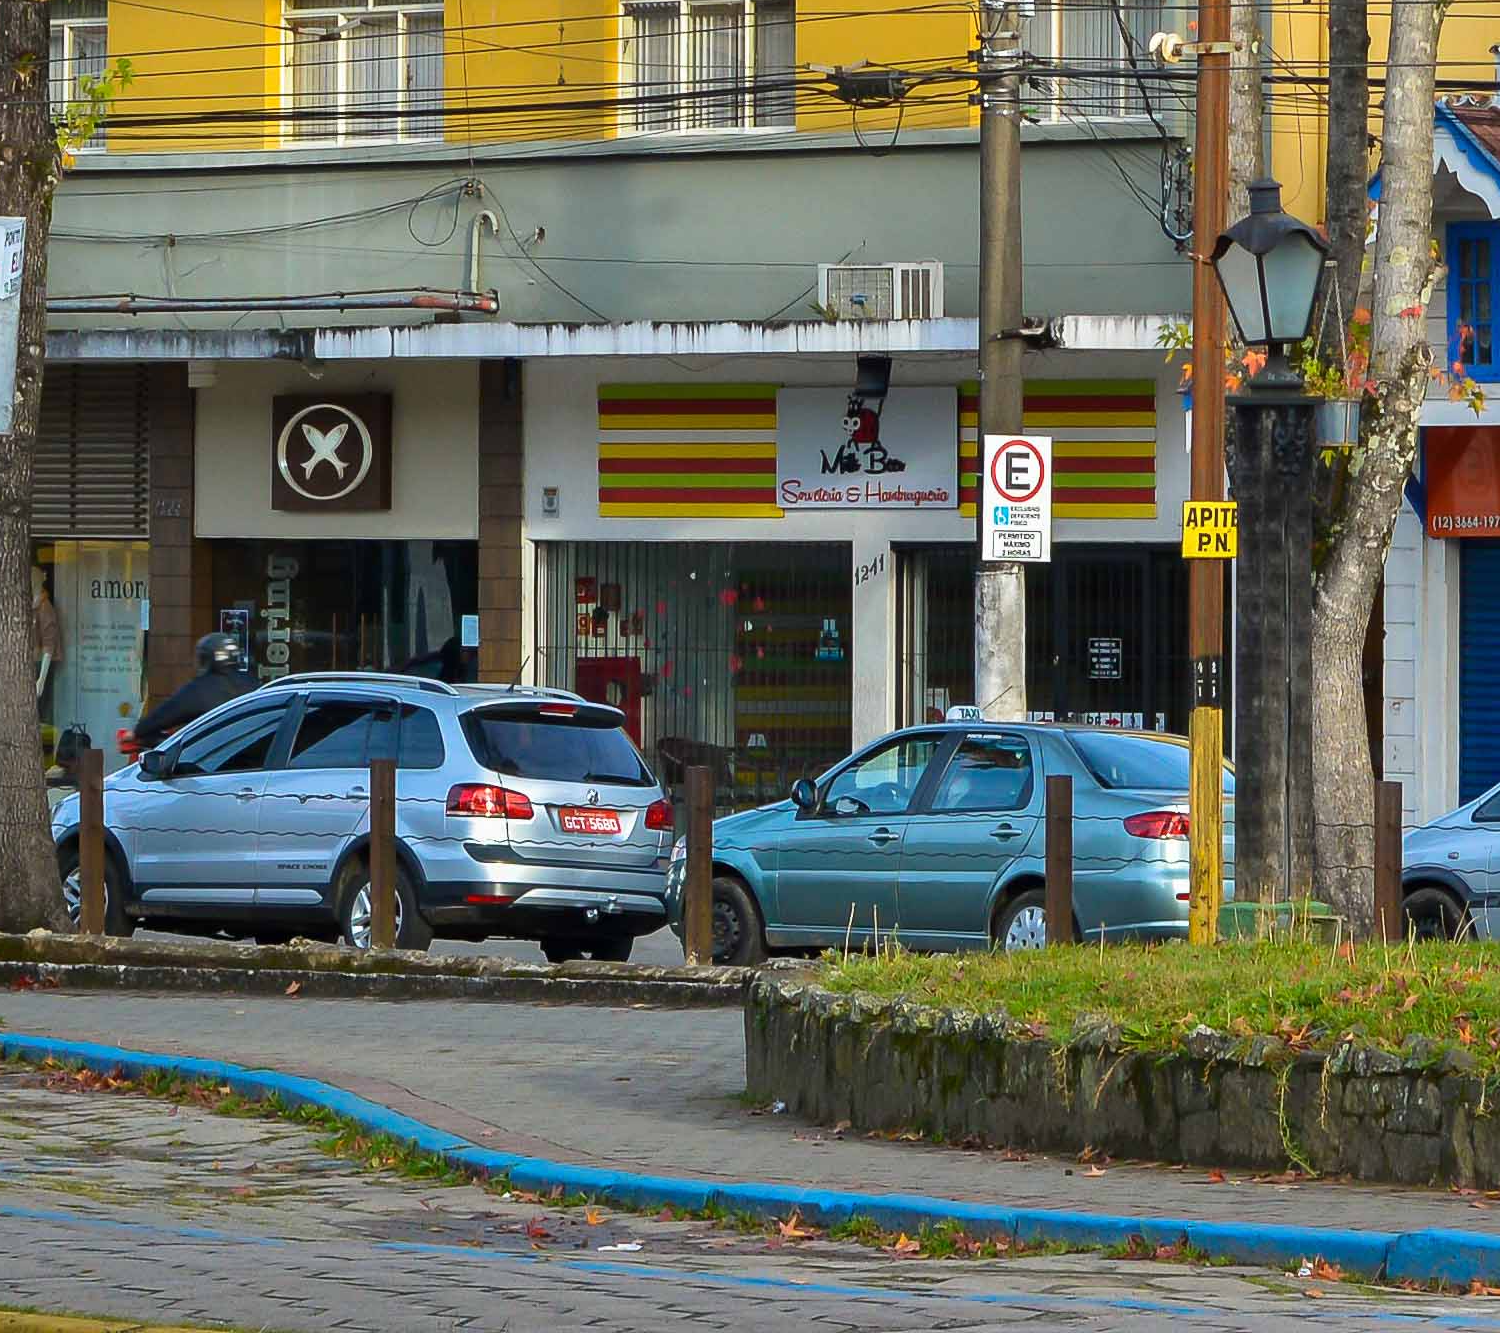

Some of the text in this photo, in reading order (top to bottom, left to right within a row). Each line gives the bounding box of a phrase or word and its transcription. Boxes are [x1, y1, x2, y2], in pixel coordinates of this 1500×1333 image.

[1004, 451, 1031, 491] E
[1431, 514, 1454, 532] (12)
[958, 708, 981, 719] TAXI
